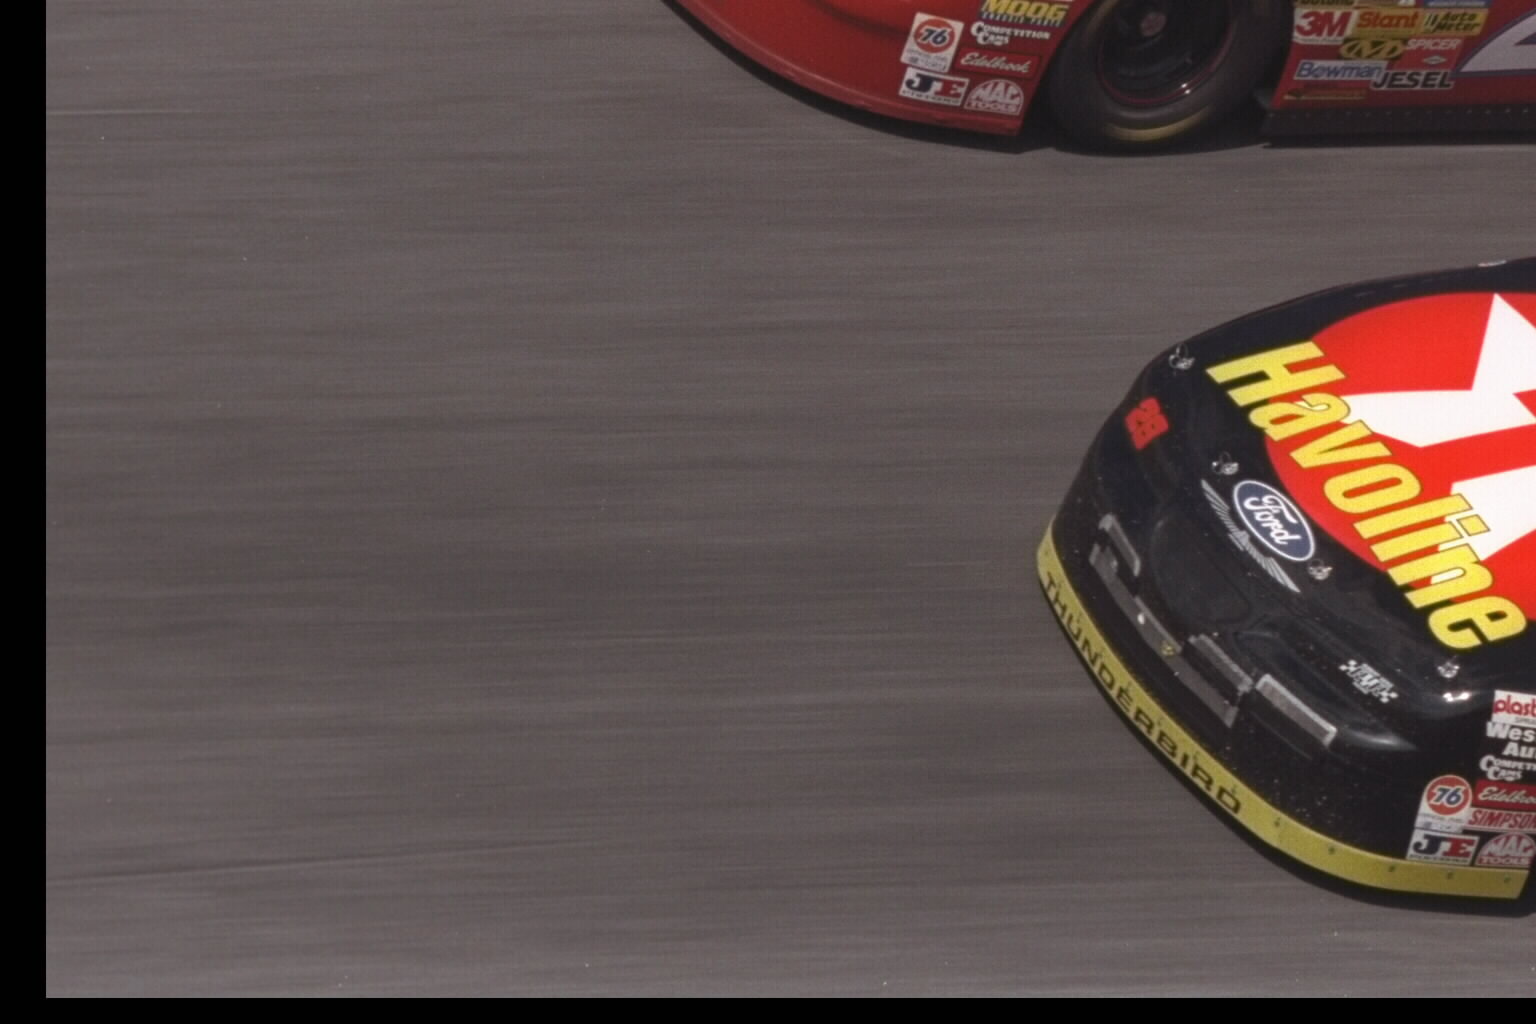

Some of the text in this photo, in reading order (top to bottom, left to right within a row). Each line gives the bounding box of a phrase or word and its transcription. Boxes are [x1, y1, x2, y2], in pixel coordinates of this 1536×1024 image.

[1295, 10, 1352, 37] 3M
[1357, 11, 1418, 29] Stant
[920, 28, 953, 46] 76
[1406, 38, 1462, 51] SPICER
[961, 51, 1032, 74] Edelbrock
[1297, 61, 1381, 78] Bowman
[905, 73, 968, 99] JE
[1373, 71, 1452, 89] JESEL
[1206, 340, 1529, 651] Havoline
[1243, 494, 1302, 545] Ford
[1044, 570, 1242, 816] THUNDERBIRD
[1430, 785, 1466, 806] 76
[1413, 834, 1476, 859] JE
[1483, 835, 1536, 857] MAC
